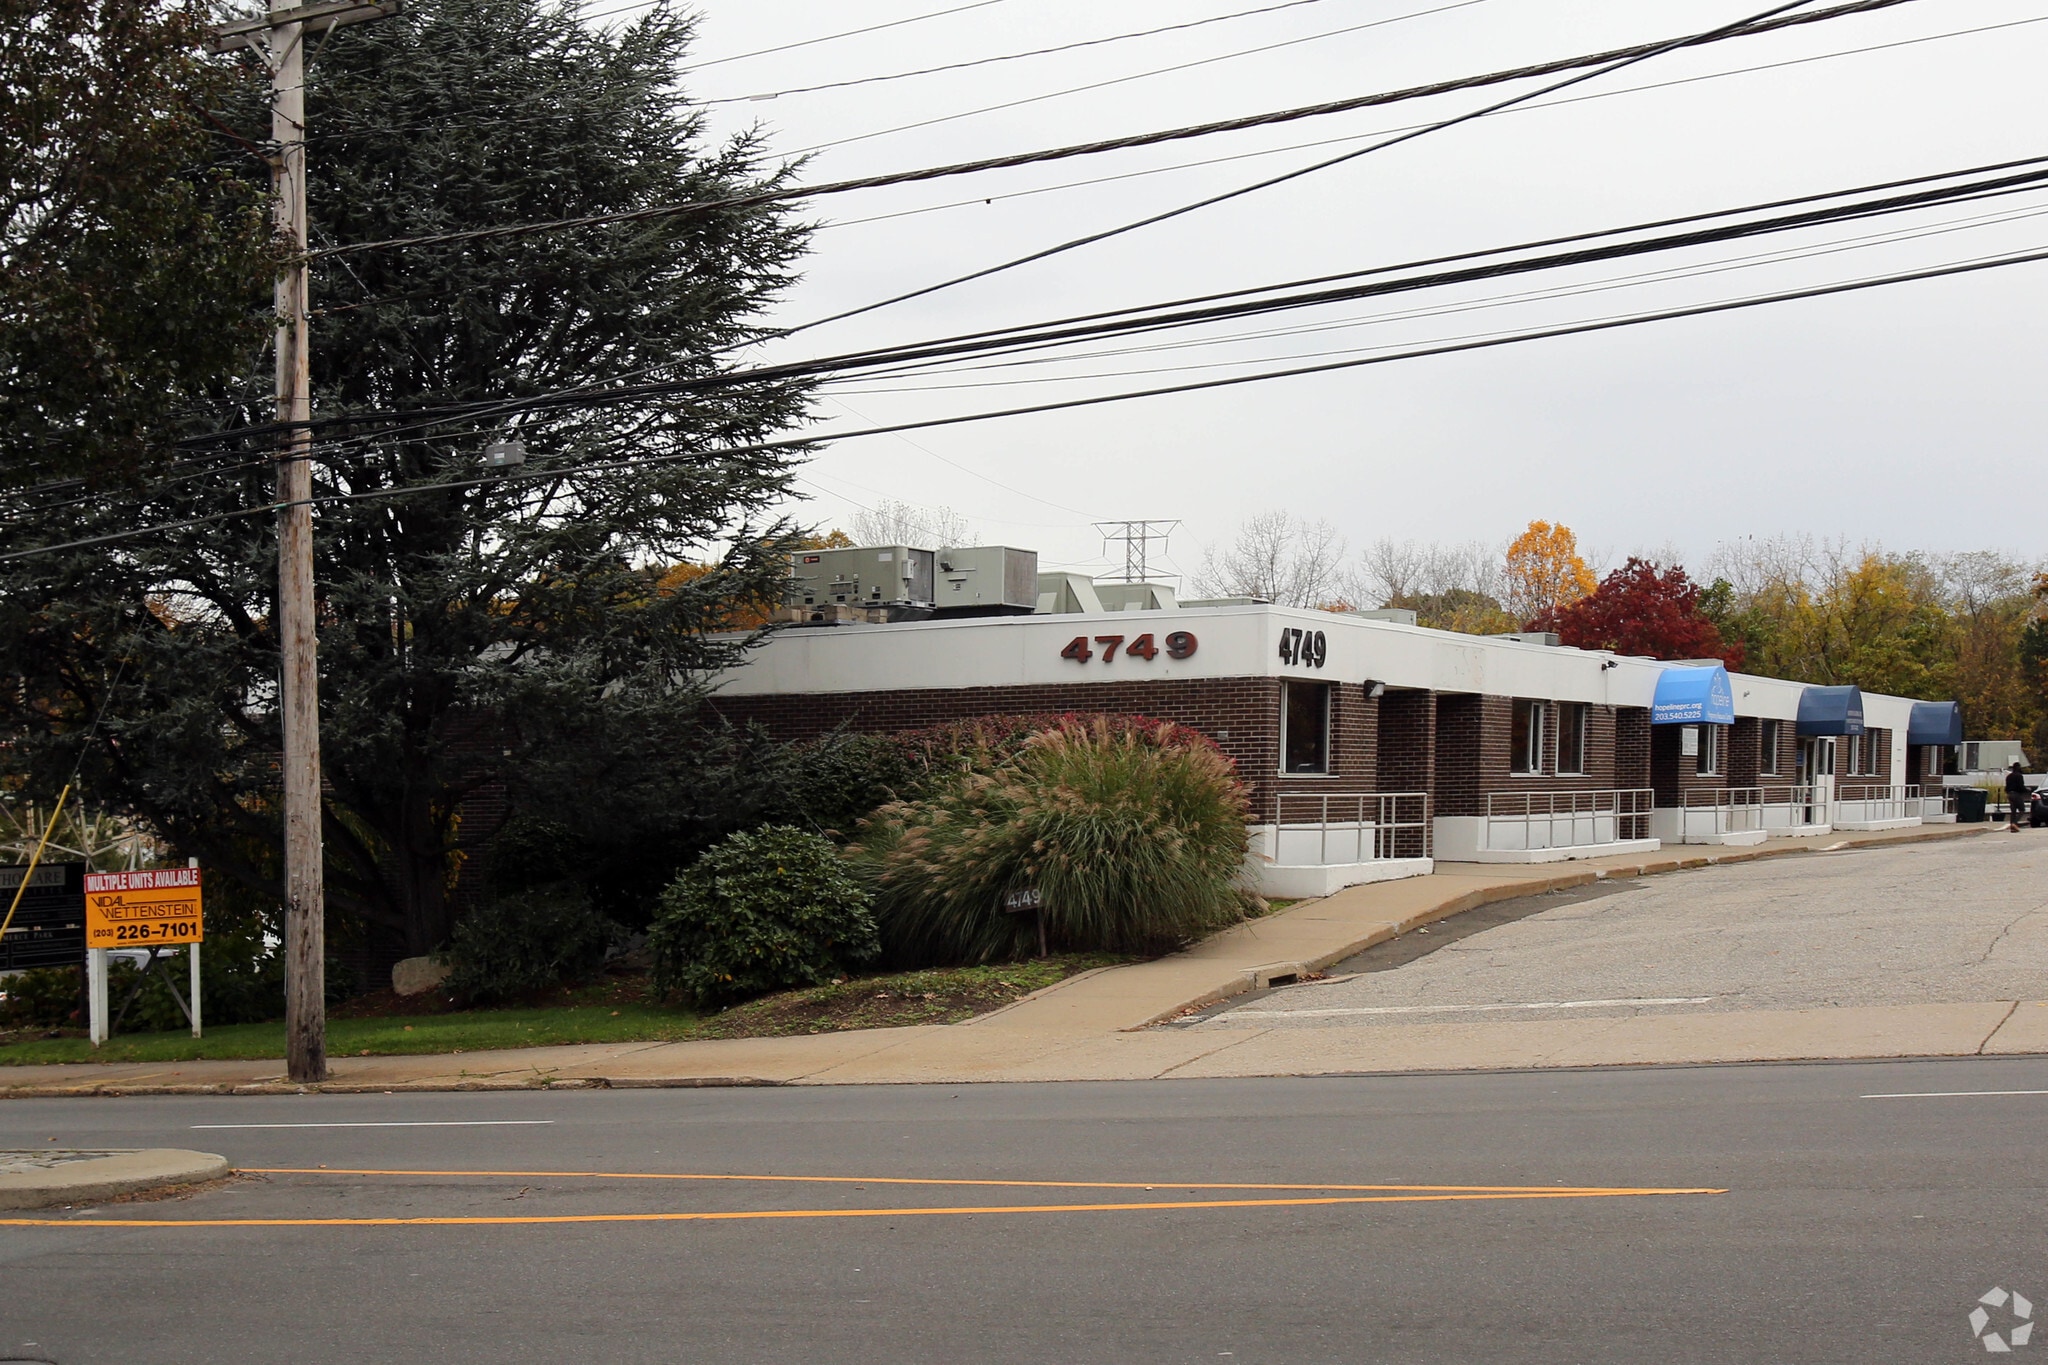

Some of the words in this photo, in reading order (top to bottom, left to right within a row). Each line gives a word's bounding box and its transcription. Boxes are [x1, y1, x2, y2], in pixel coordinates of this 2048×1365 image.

[1061, 631, 1198, 663] 4749
[1279, 627, 1327, 668] 4749
[1655, 703, 1702, 711] hopelineprc.org
[1655, 711, 1701, 720] 203.540.5225
[87, 874, 127, 892] MULTIPLE
[128, 872, 153, 889] UNITS
[155, 869, 198, 888] AVAILABLE
[91, 896, 125, 907] VIDAL
[1007, 888, 1041, 908] 4749
[99, 904, 194, 918] WETTENSTEIN
[93, 928, 113, 938] (203)
[117, 922, 197, 940] 226-7101
